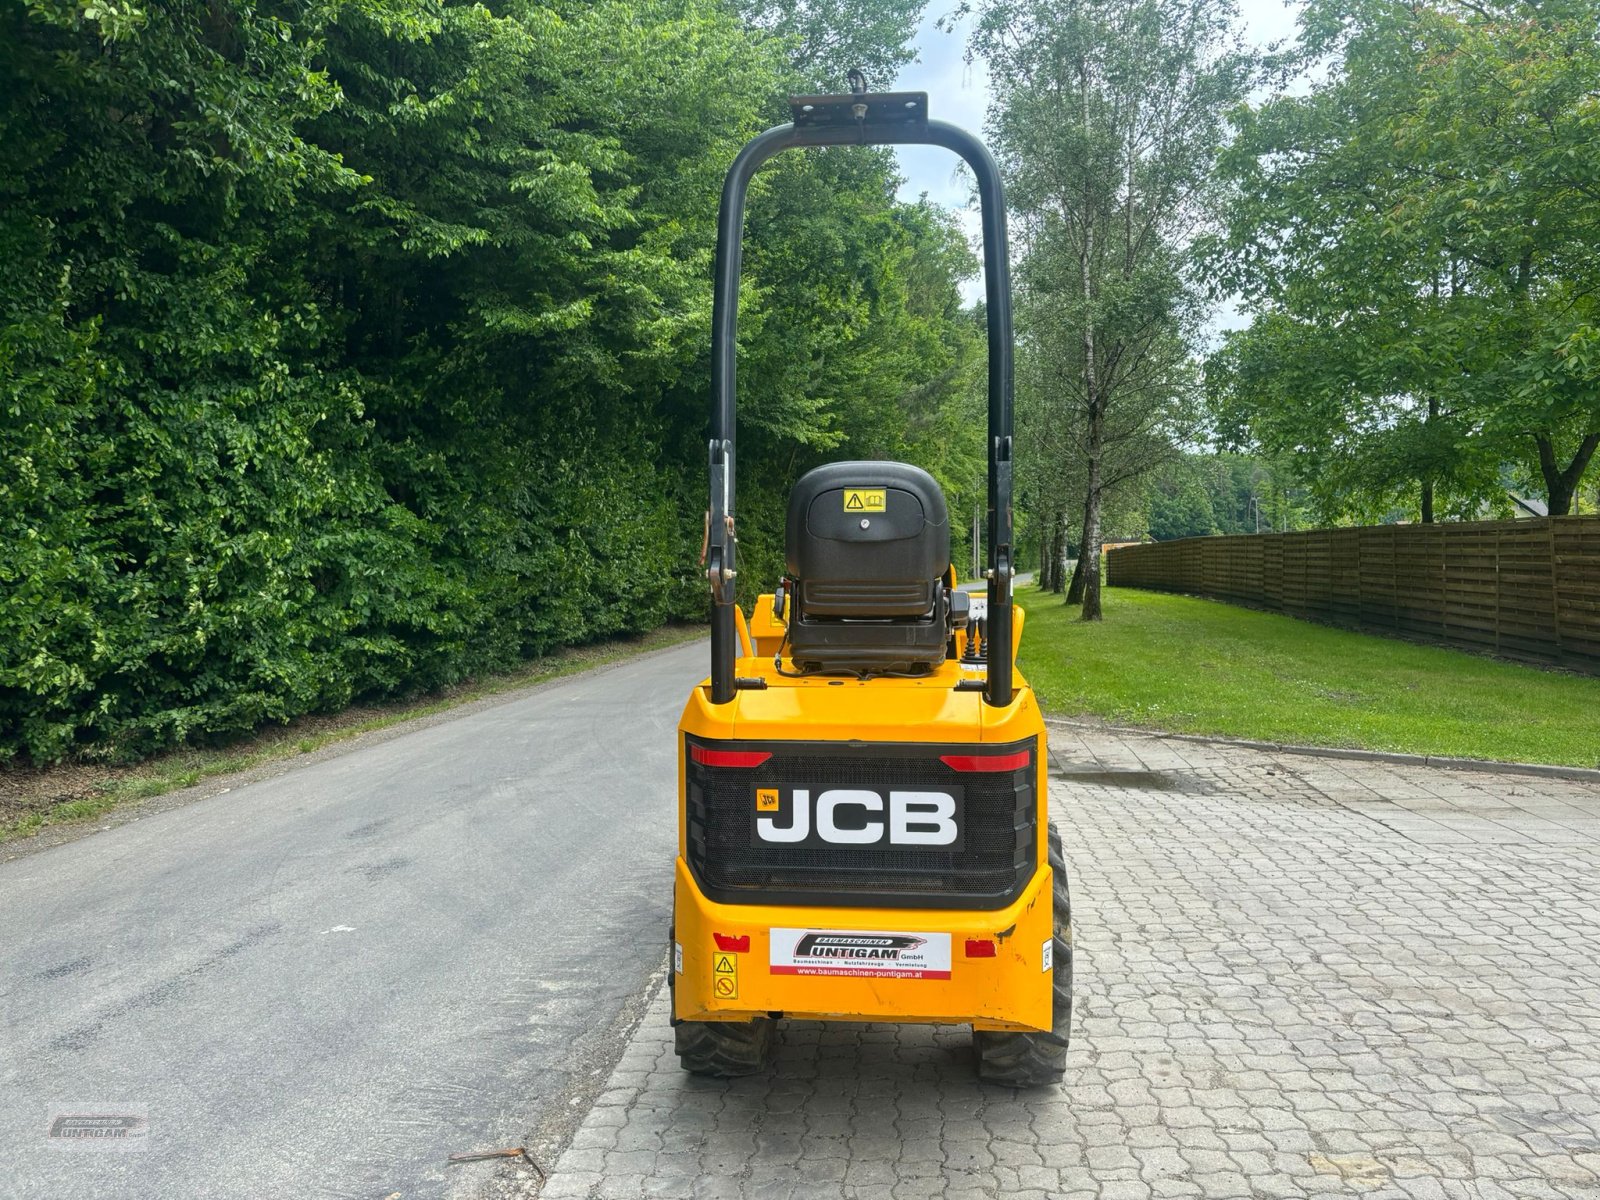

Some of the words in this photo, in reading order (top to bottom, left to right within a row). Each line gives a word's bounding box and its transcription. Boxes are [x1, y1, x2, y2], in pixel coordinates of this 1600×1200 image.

[757, 789, 958, 845] JCB
[818, 937, 889, 945] BAUMASCHINEN
[797, 967, 922, 978] www.baumaschinen-puntigam.at
